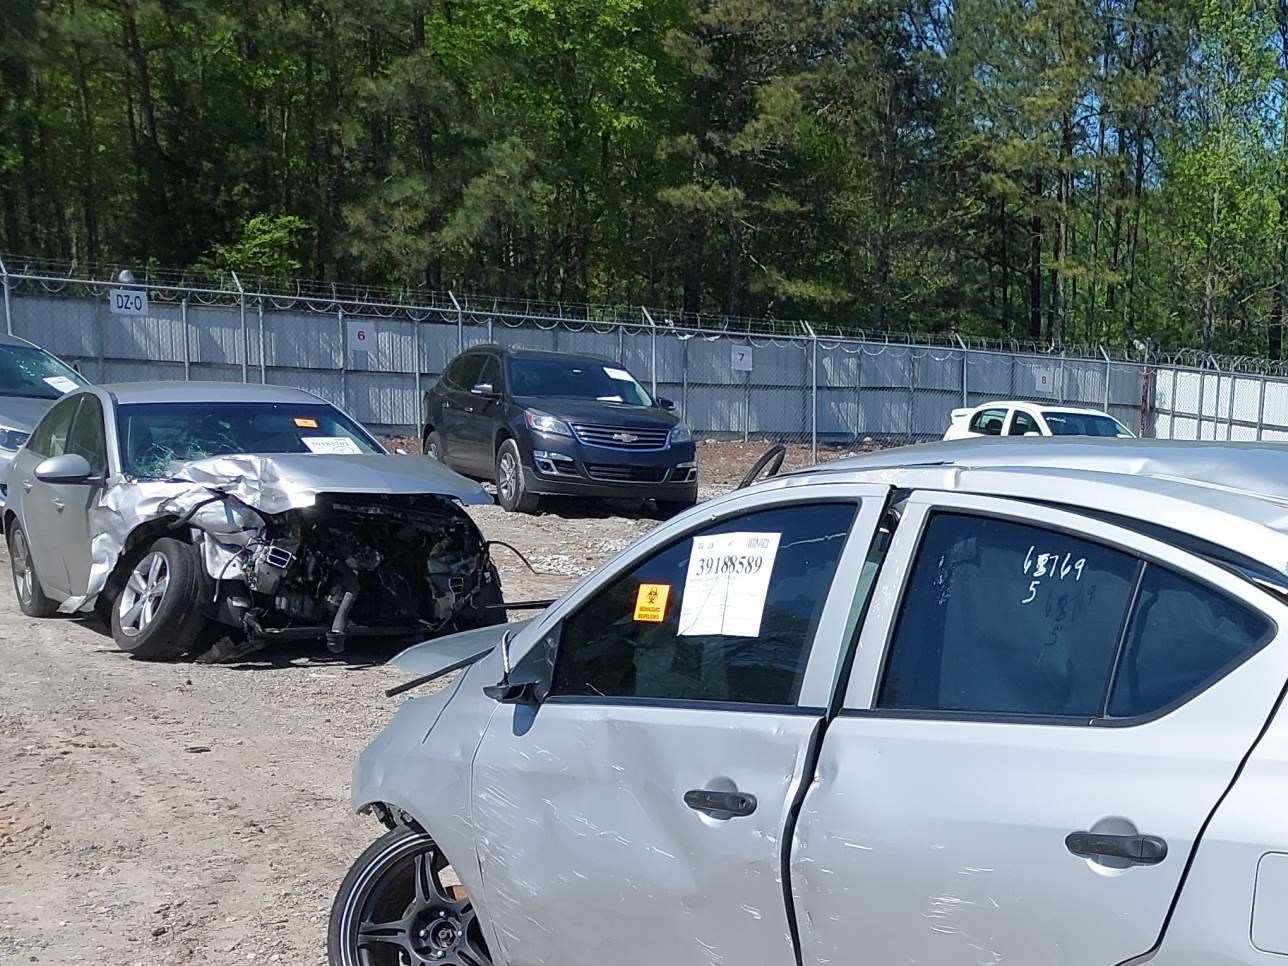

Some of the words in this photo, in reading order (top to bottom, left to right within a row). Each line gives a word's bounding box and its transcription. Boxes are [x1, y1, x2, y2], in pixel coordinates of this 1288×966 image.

[357, 330, 366, 341] 6
[737, 352, 745, 362] 7
[696, 554, 763, 576] 39188589
[1021, 581, 1041, 604] 5
